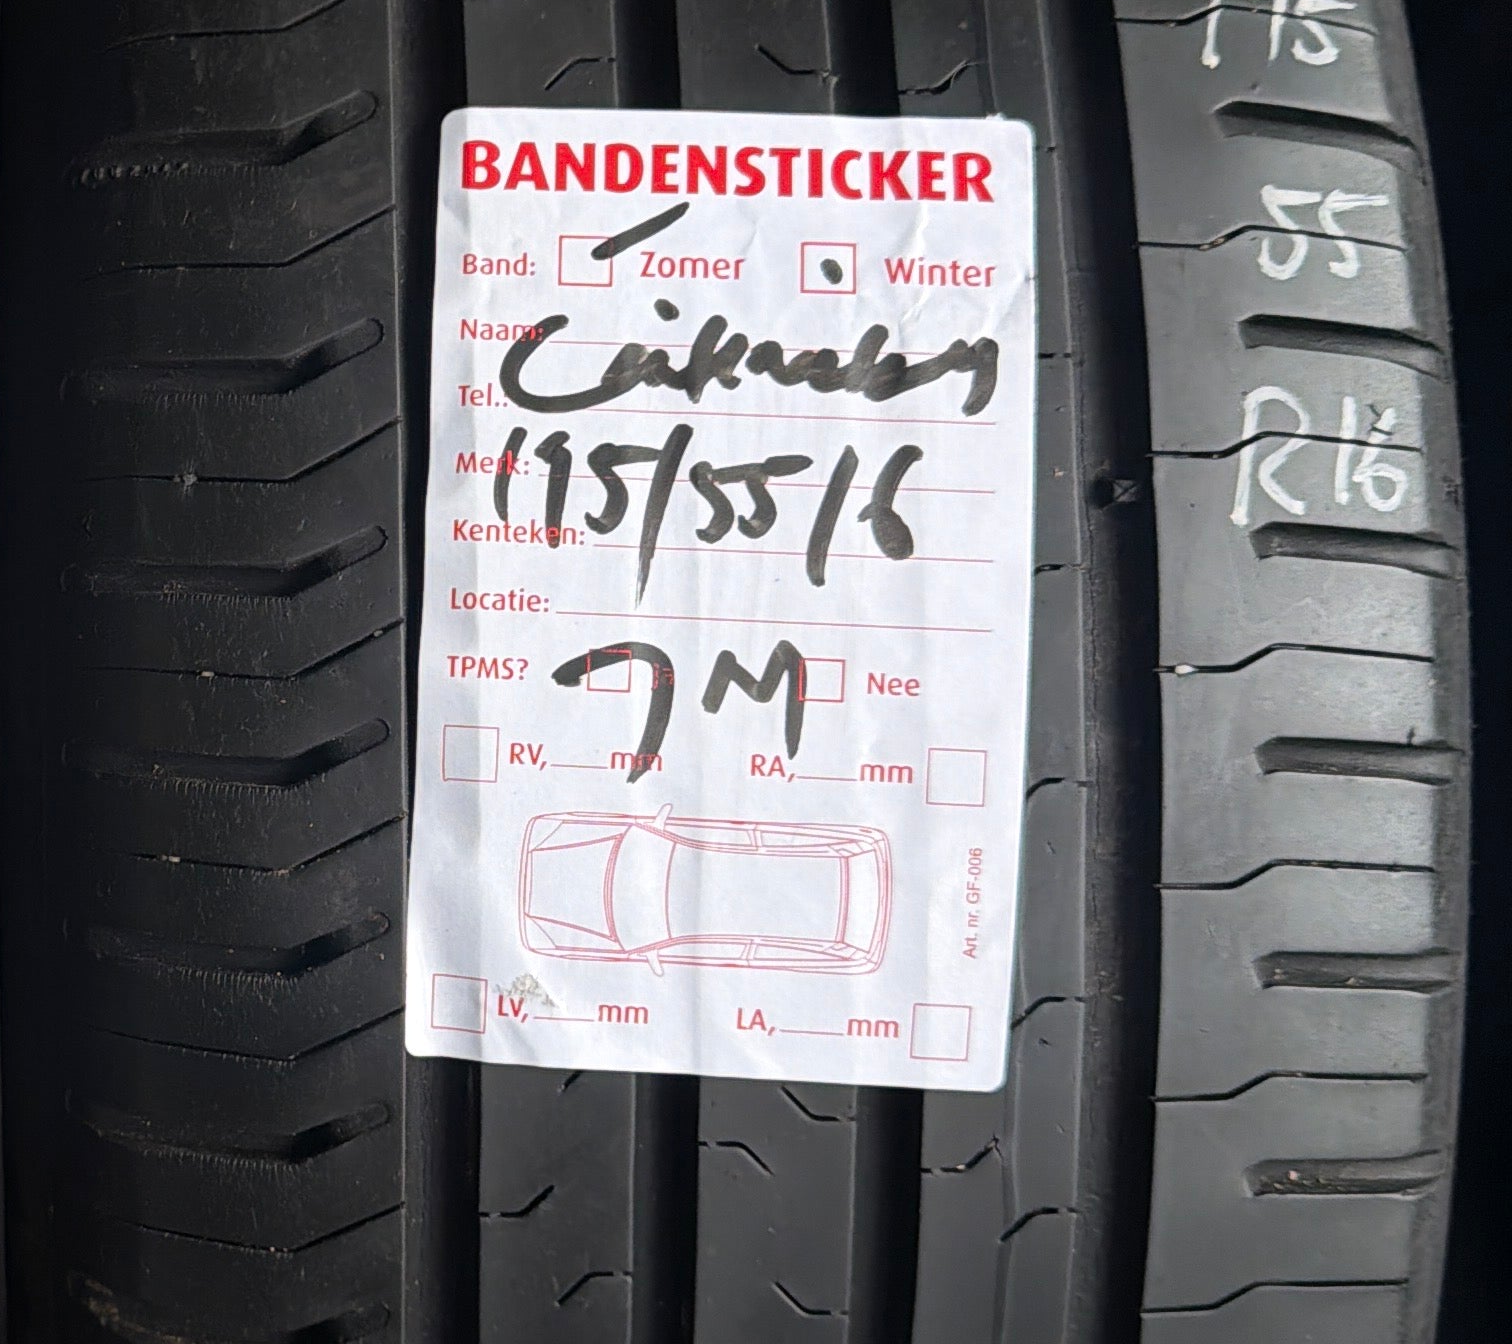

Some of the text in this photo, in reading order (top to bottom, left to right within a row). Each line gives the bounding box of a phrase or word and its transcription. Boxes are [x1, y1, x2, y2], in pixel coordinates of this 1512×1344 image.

[460, 140, 995, 203] BANDENSTICKER
[1256, 184, 1389, 280] 55
[462, 251, 995, 288] Band: Zomer Winter
[1231, 384, 1408, 524] R16
[450, 587, 549, 613] Locatie:
[447, 657, 920, 697] TPMS? Nee
[967, 847, 983, 905] GF-006
